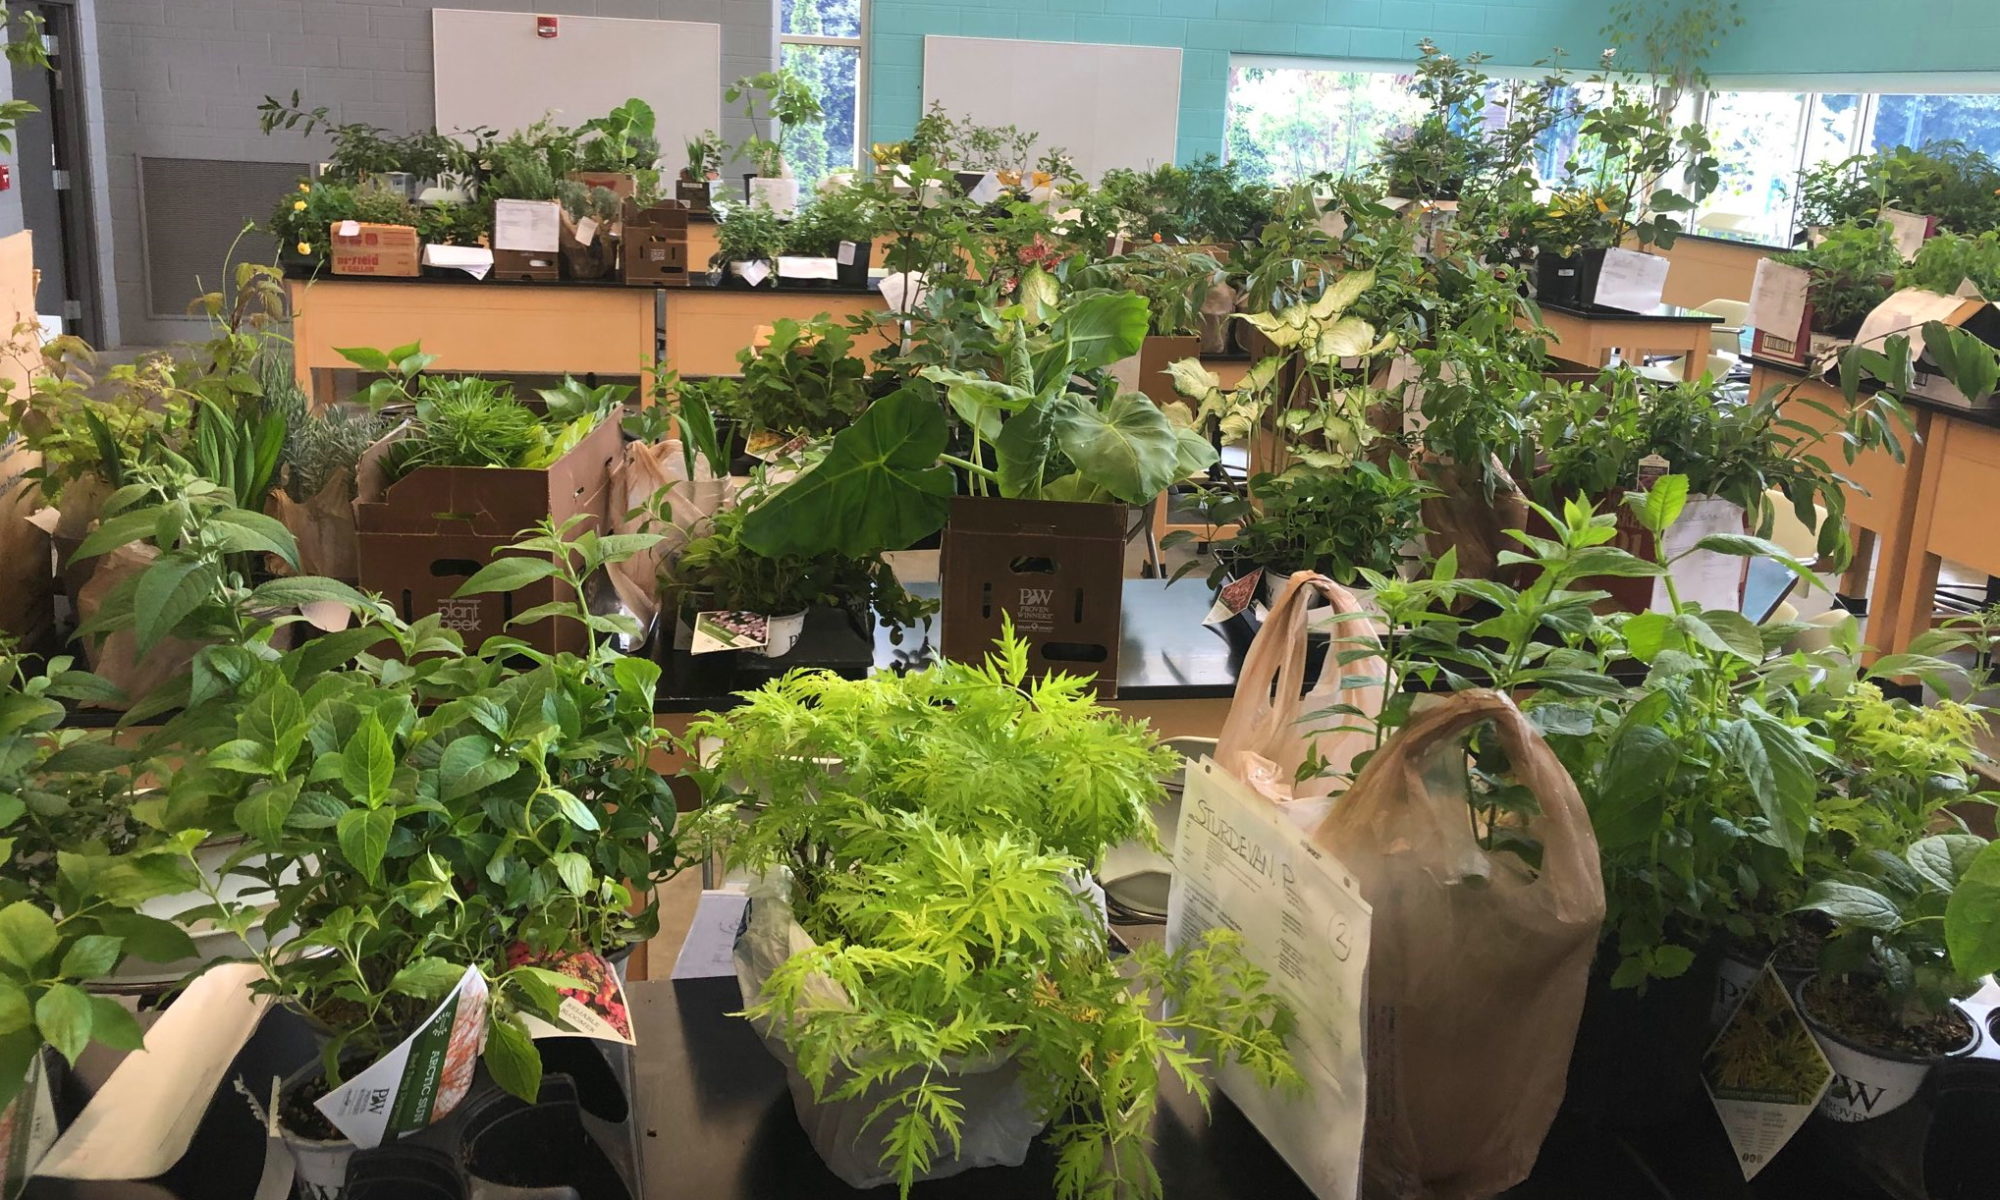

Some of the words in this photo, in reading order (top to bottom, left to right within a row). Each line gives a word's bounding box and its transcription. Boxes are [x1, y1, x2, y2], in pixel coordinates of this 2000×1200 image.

[566, 1002, 601, 1028] RELIABLE
[421, 1051, 440, 1095] ARCTIC
[369, 1088, 390, 1115] PW
[413, 1097, 429, 1124] SUN
